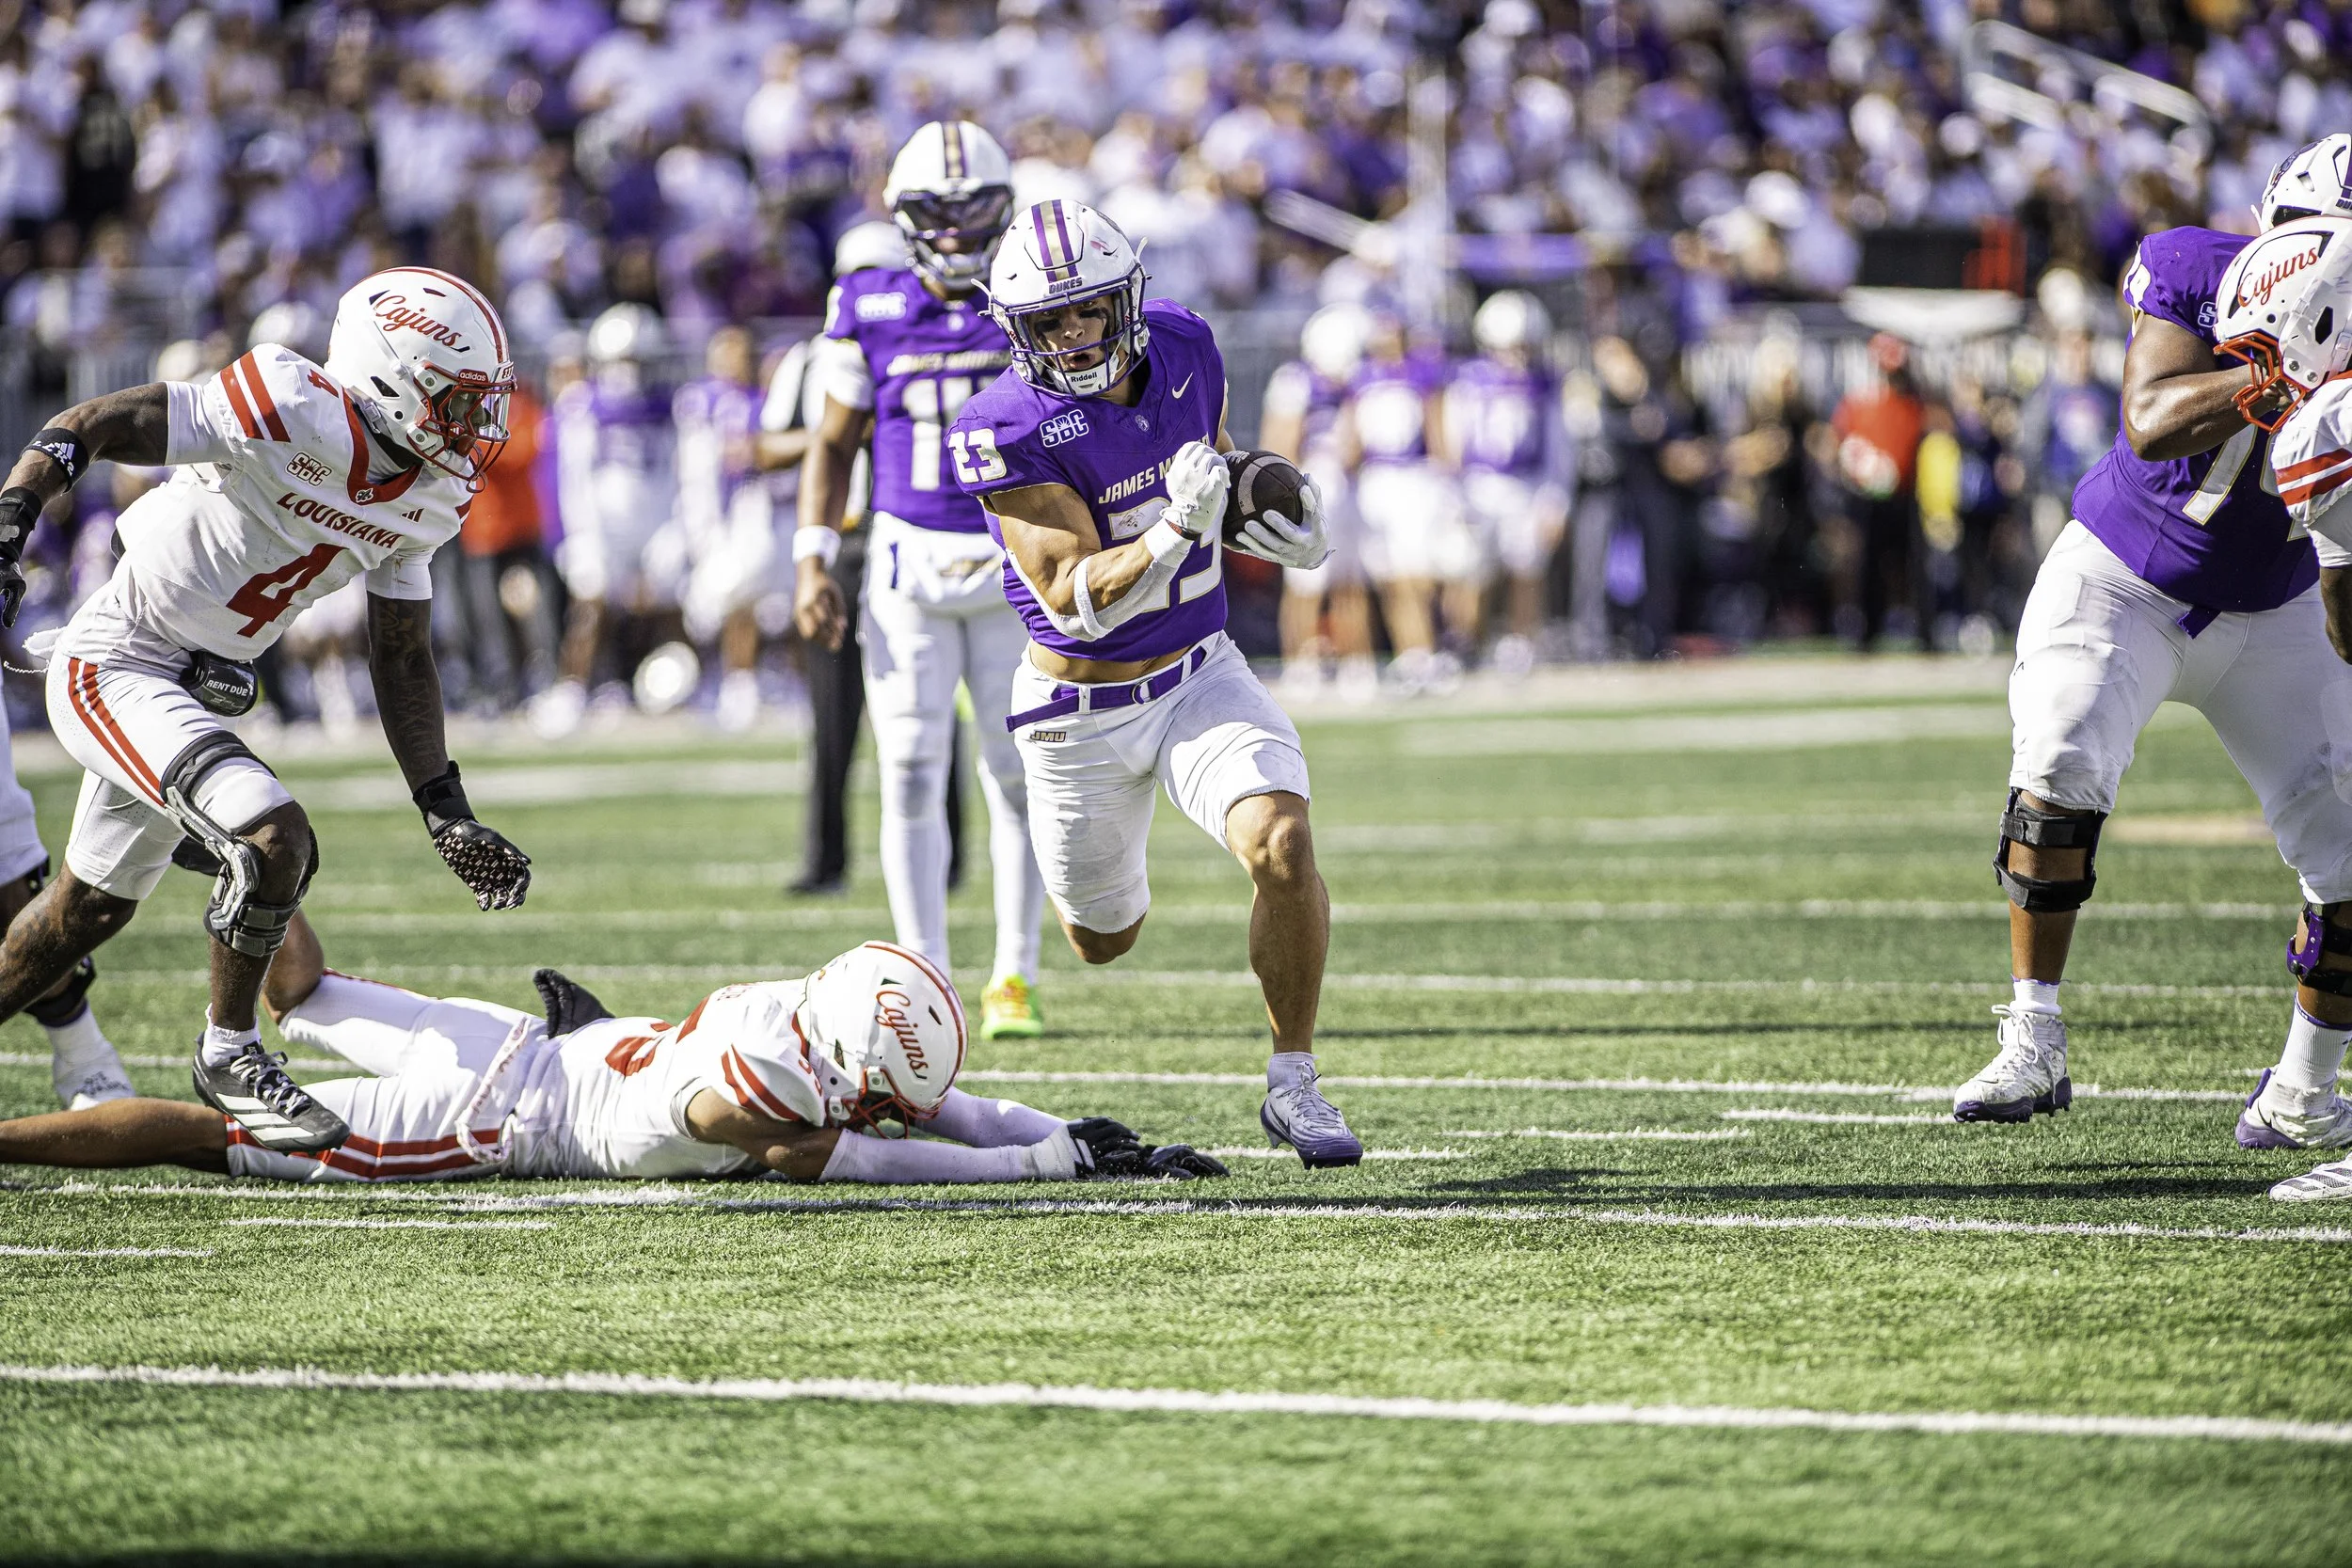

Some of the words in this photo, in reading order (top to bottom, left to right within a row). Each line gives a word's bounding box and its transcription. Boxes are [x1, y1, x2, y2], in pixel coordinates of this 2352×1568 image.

[1048, 277, 1083, 294] DUKES
[2237, 246, 2318, 309] Cajuns
[373, 295, 462, 347] Cajuns
[308, 369, 340, 398] 4
[459, 372, 486, 382] adidas
[1071, 372, 1098, 383] Riddell
[1040, 408, 1089, 448] SBC
[286, 451, 332, 487] SBC
[947, 428, 1007, 483] 23
[1098, 467, 1155, 505] JAMES
[276, 492, 405, 550] LOUISIANA
[225, 543, 351, 639] 4
[206, 679, 230, 692] RENT
[230, 685, 248, 697] DUE
[1030, 730, 1067, 743] JMU
[875, 990, 929, 1072] Cajuns
